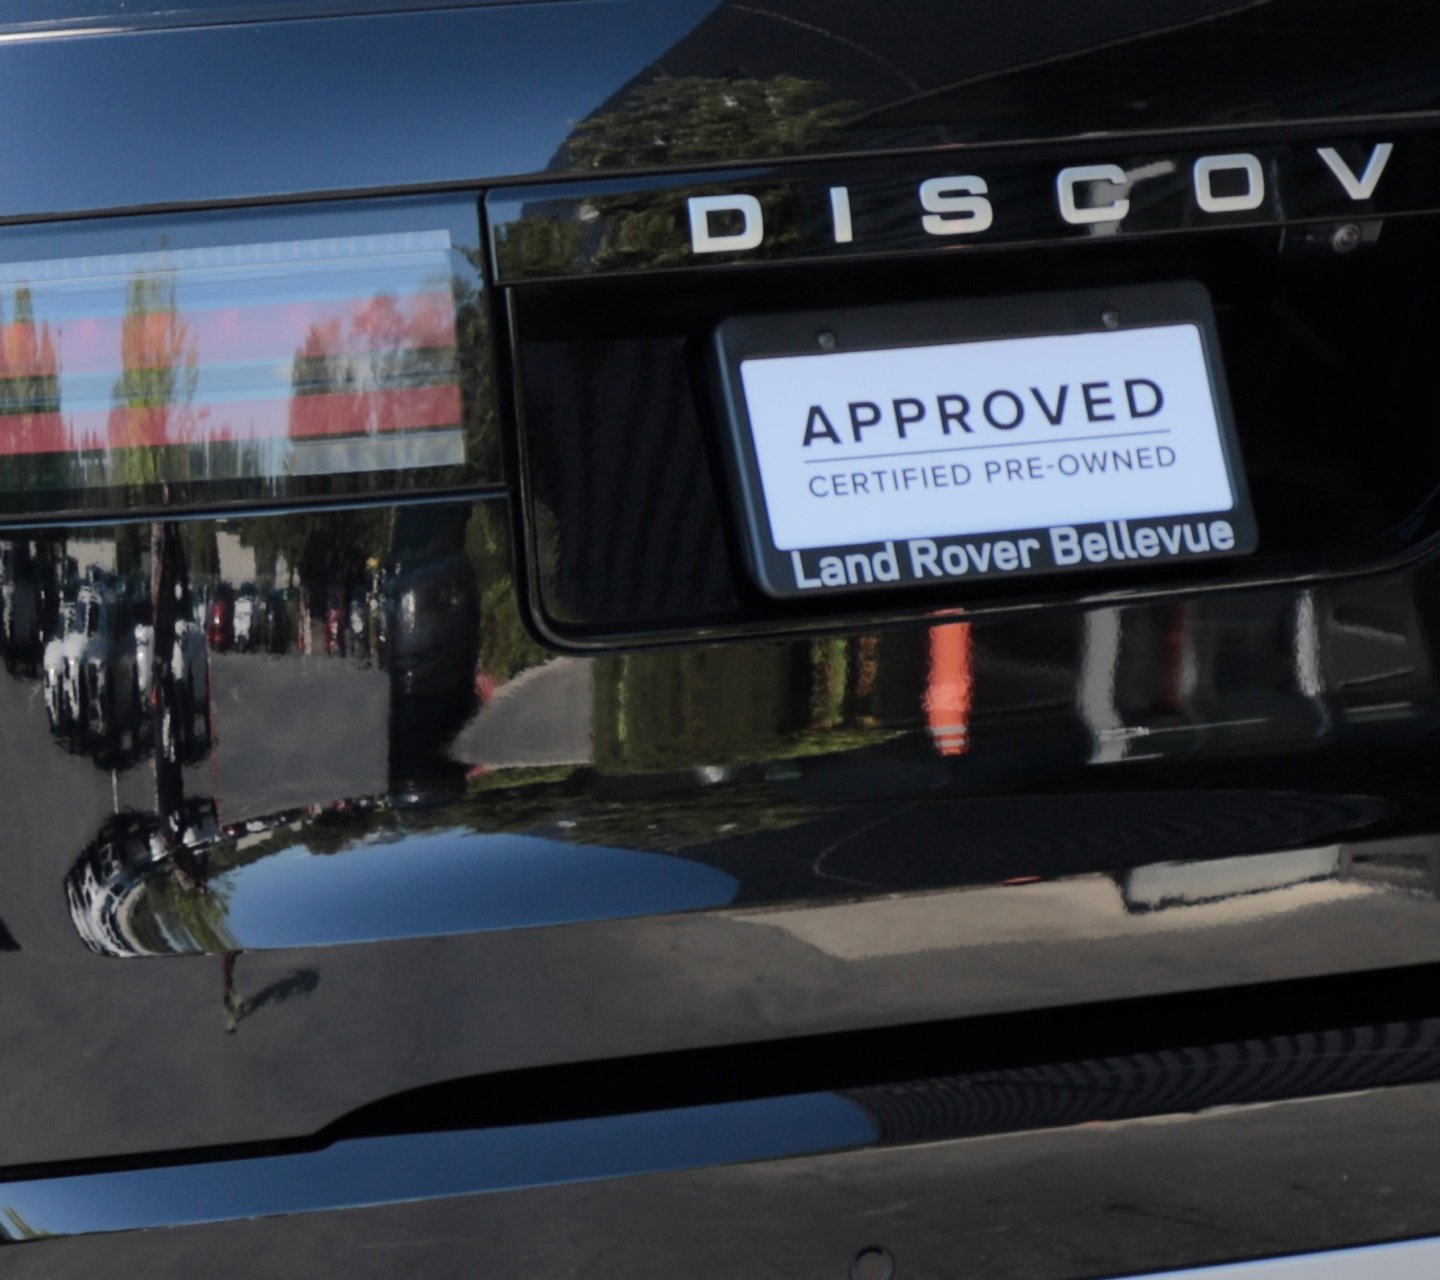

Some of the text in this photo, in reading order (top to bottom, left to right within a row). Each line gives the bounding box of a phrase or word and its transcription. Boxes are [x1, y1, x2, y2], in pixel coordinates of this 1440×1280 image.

[801, 377, 1166, 448] APPROVED
[807, 445, 1177, 498] CERTIFIED PRE-OWNED
[790, 519, 1235, 590] Land Rover Bellevue
